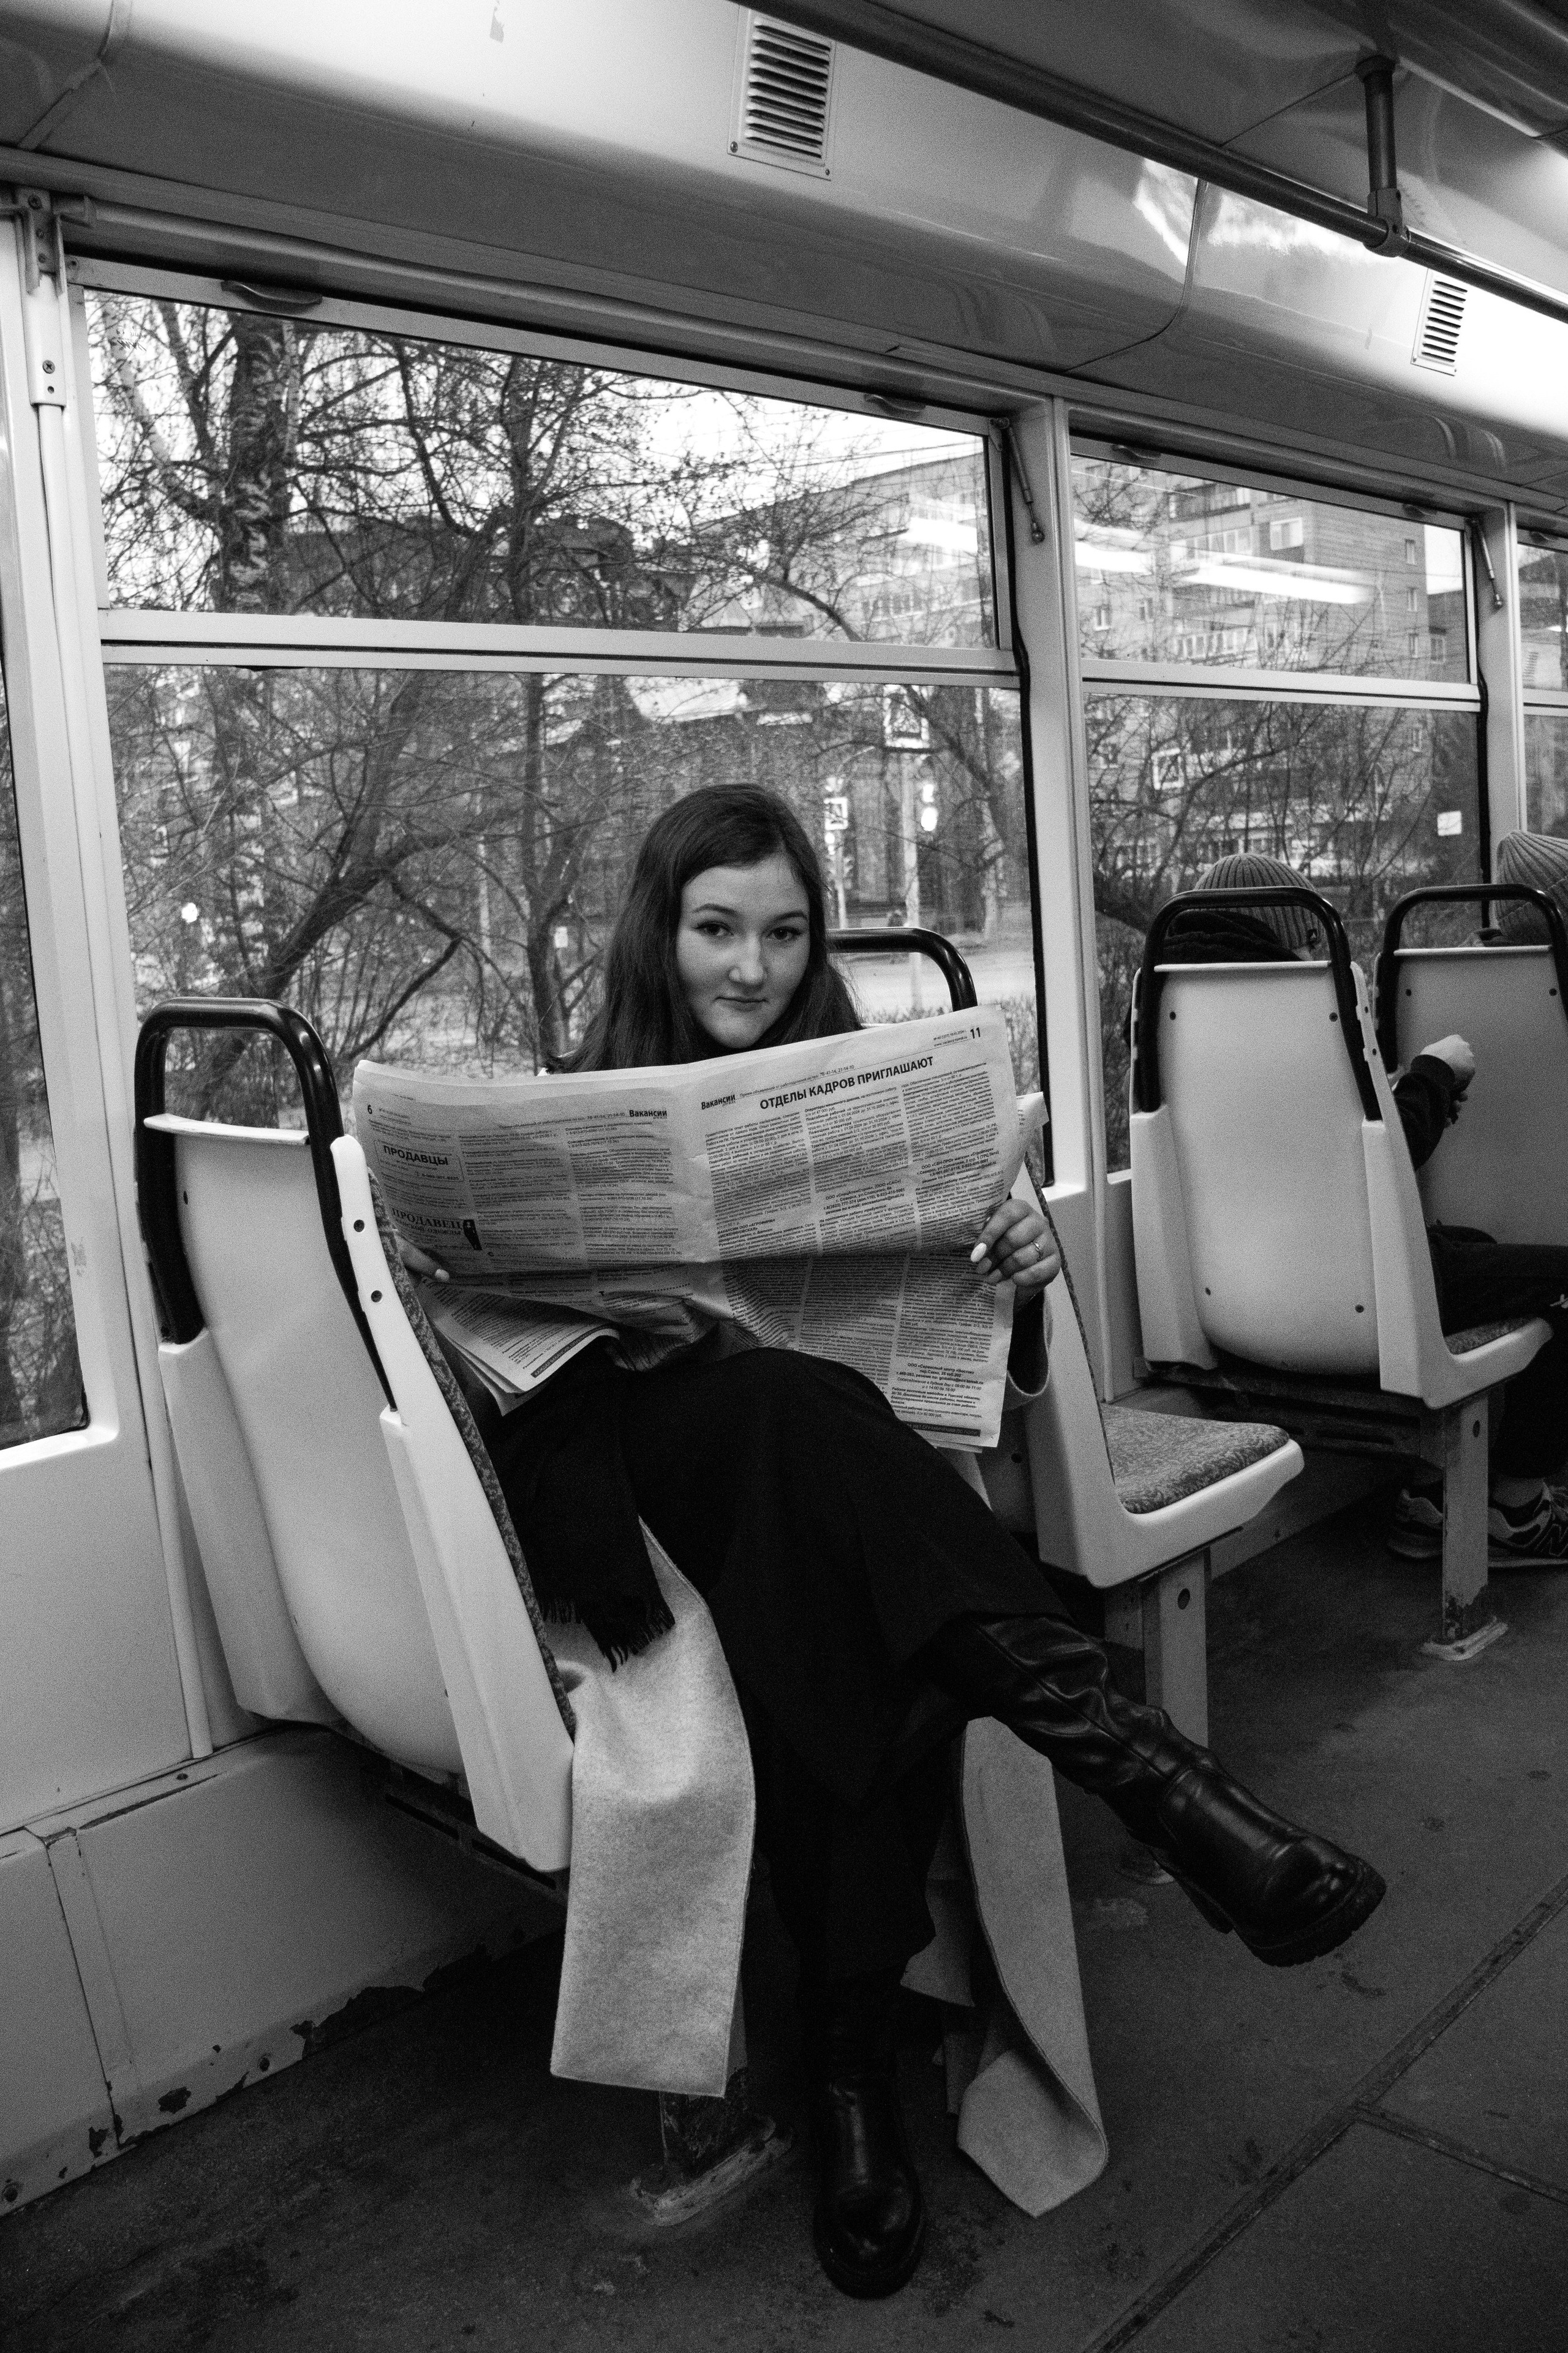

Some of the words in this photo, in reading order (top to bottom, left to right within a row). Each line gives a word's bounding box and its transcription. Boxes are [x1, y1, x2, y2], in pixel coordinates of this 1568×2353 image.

[970, 1027, 981, 1039] 11
[760, 1089, 807, 1110] ОТДЕЛЫ
[809, 1076, 855, 1097] КАДРОВ
[857, 1056, 933, 1084] ПРИГЛАШАЮТ
[368, 1105, 372, 1114] 6
[701, 1093, 736, 1110] Вакансии
[383, 1145, 448, 1166] ПРОДАВЦЫ
[392, 1207, 462, 1229] ПРОДАВЕЦ
